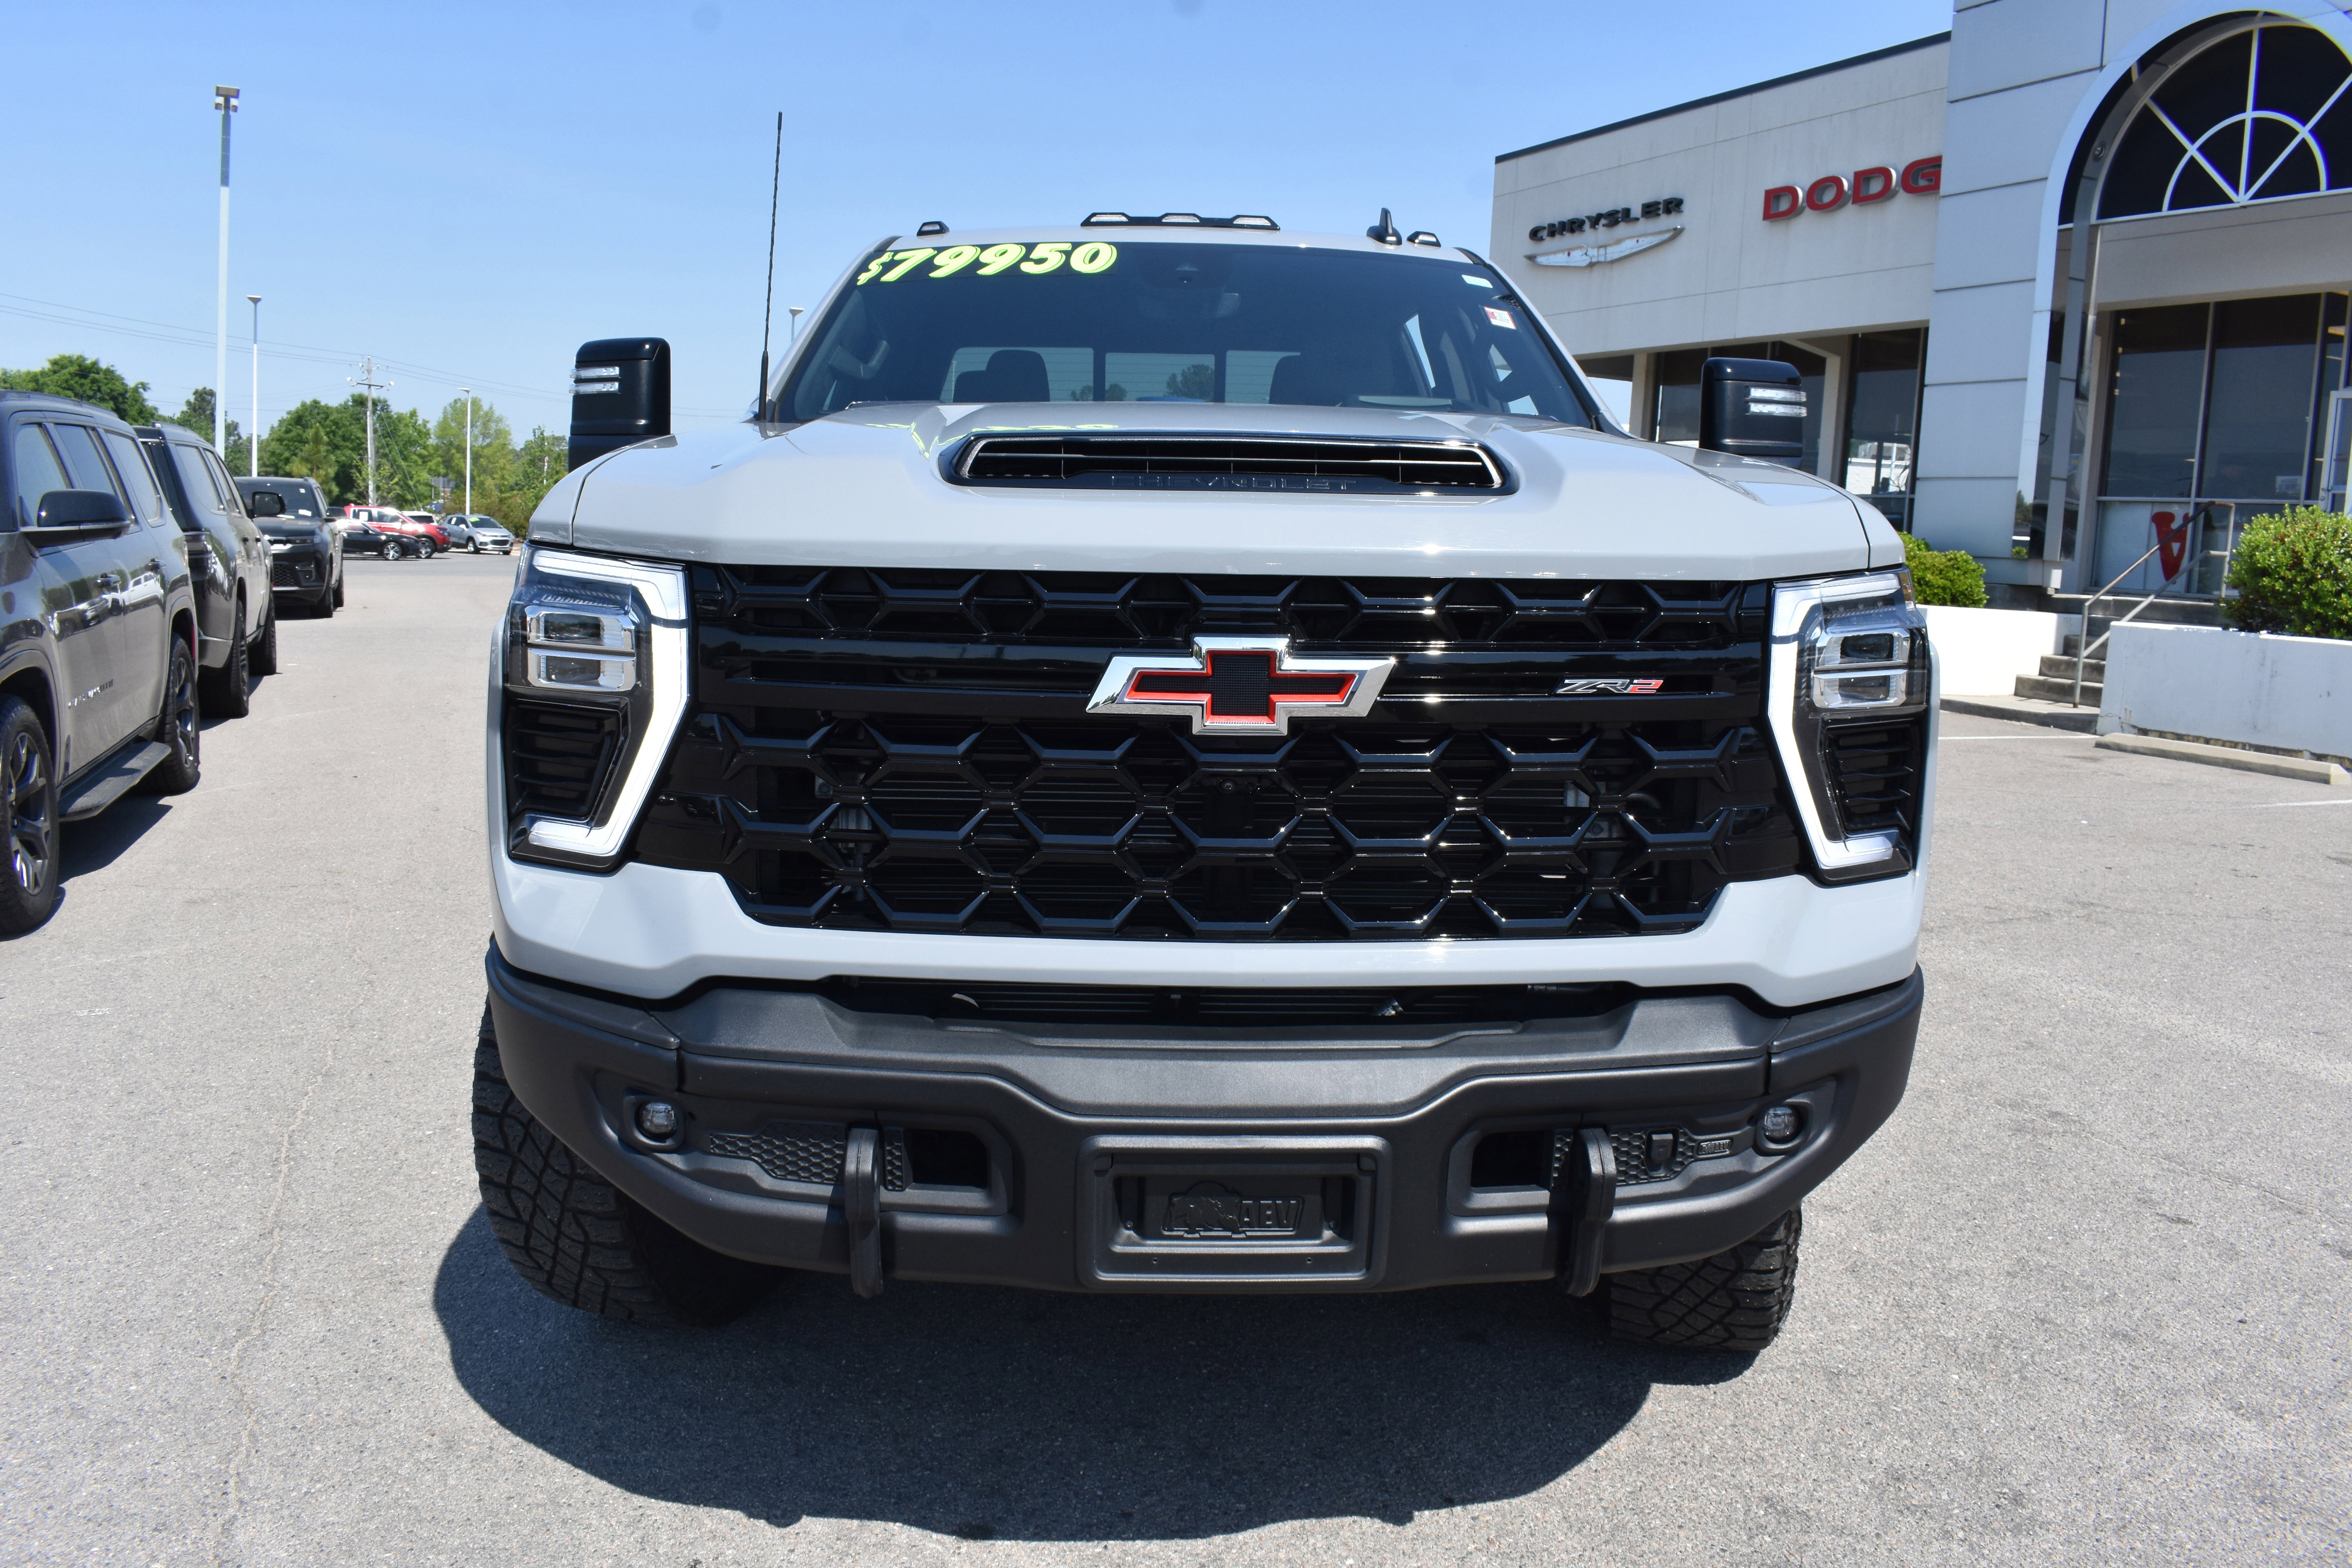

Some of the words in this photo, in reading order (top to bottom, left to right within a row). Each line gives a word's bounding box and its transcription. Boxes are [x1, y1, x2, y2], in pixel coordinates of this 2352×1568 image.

[1529, 197, 1685, 242] CHRYSLER
[856, 243, 1117, 285] $79950
[1111, 475, 1356, 490] CHEVROLET
[1556, 679, 1664, 694] ZR2
[1239, 1200, 1298, 1228] AEV
